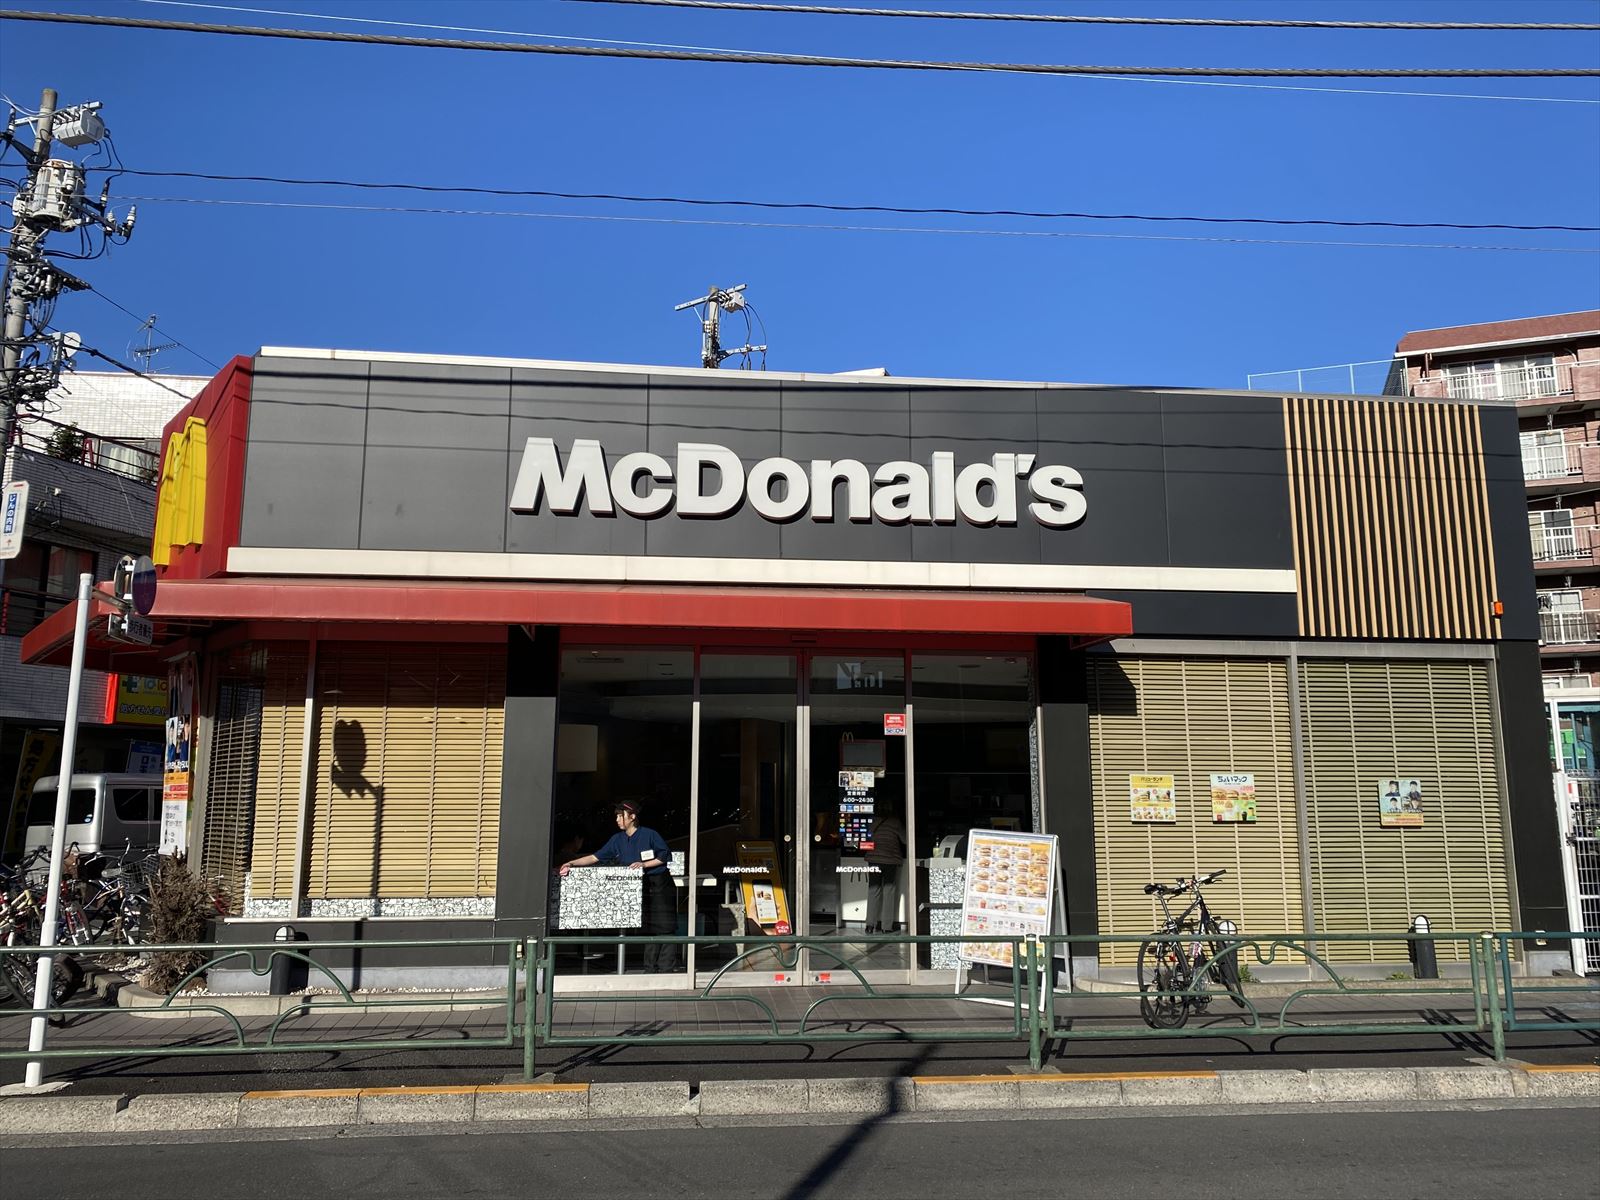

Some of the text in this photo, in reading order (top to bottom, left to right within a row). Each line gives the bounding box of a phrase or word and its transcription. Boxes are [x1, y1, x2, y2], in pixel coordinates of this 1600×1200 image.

[509, 437, 1088, 527] McDonald's
[1217, 775, 1247, 783] ちょいマック
[722, 866, 769, 874] McDonald's
